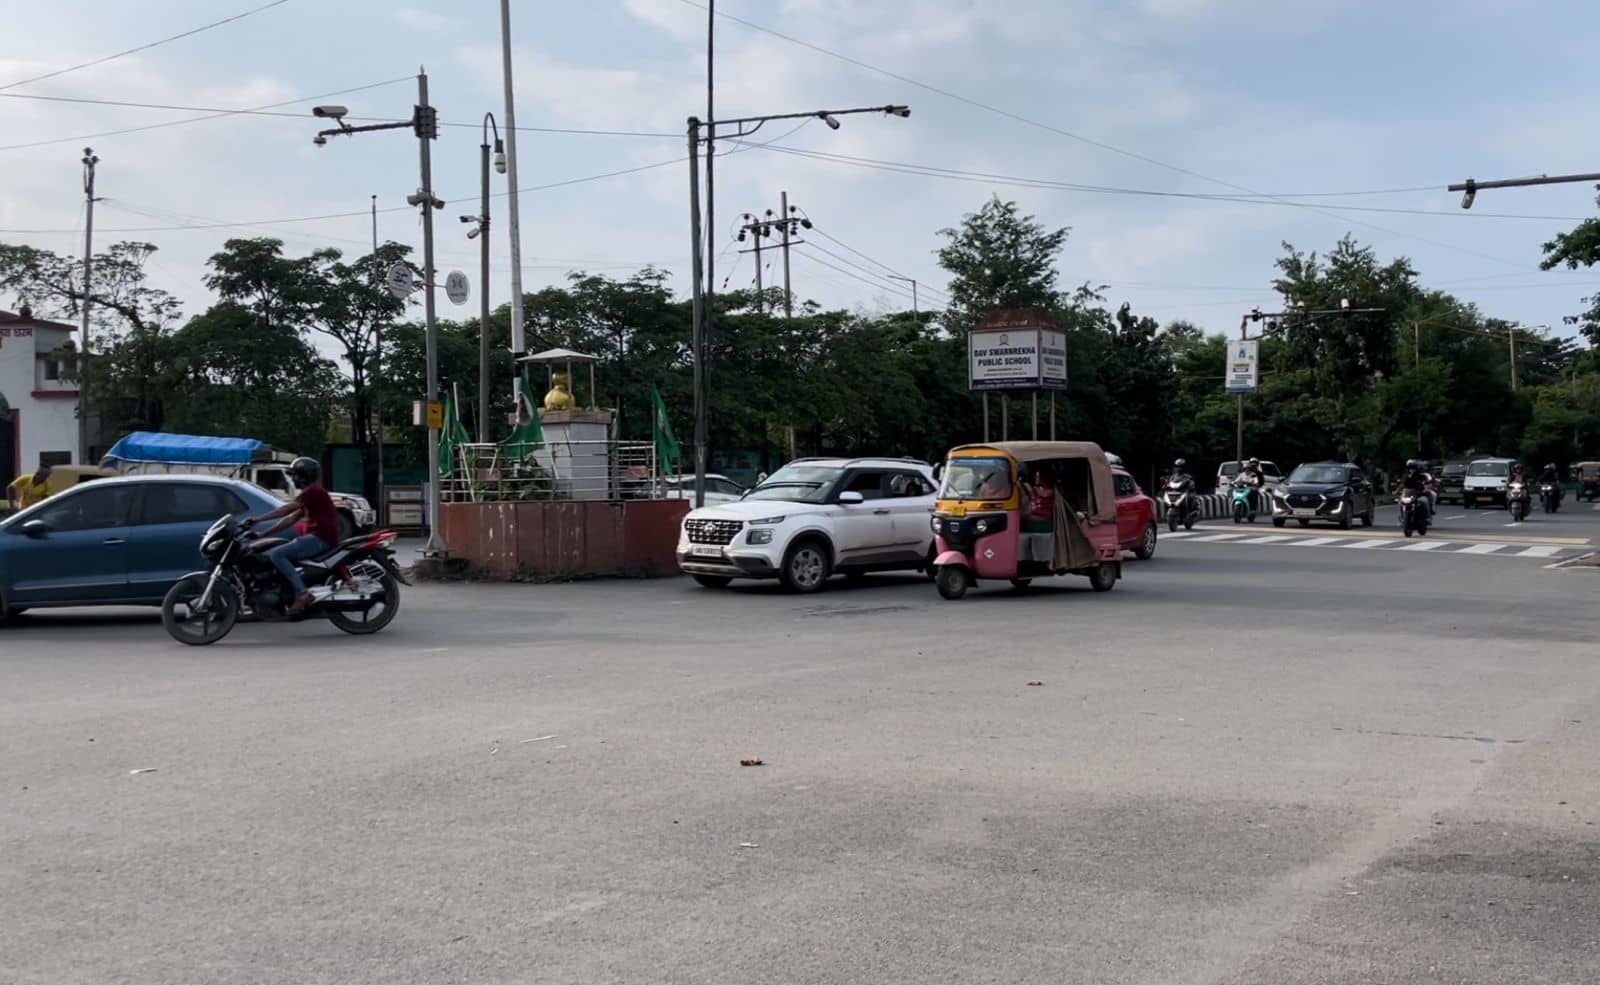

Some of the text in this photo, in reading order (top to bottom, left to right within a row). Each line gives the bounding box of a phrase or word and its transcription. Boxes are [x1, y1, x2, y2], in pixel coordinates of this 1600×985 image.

[974, 349, 988, 357] DAV
[978, 357, 1032, 366] PUBLIC SCHOOL
